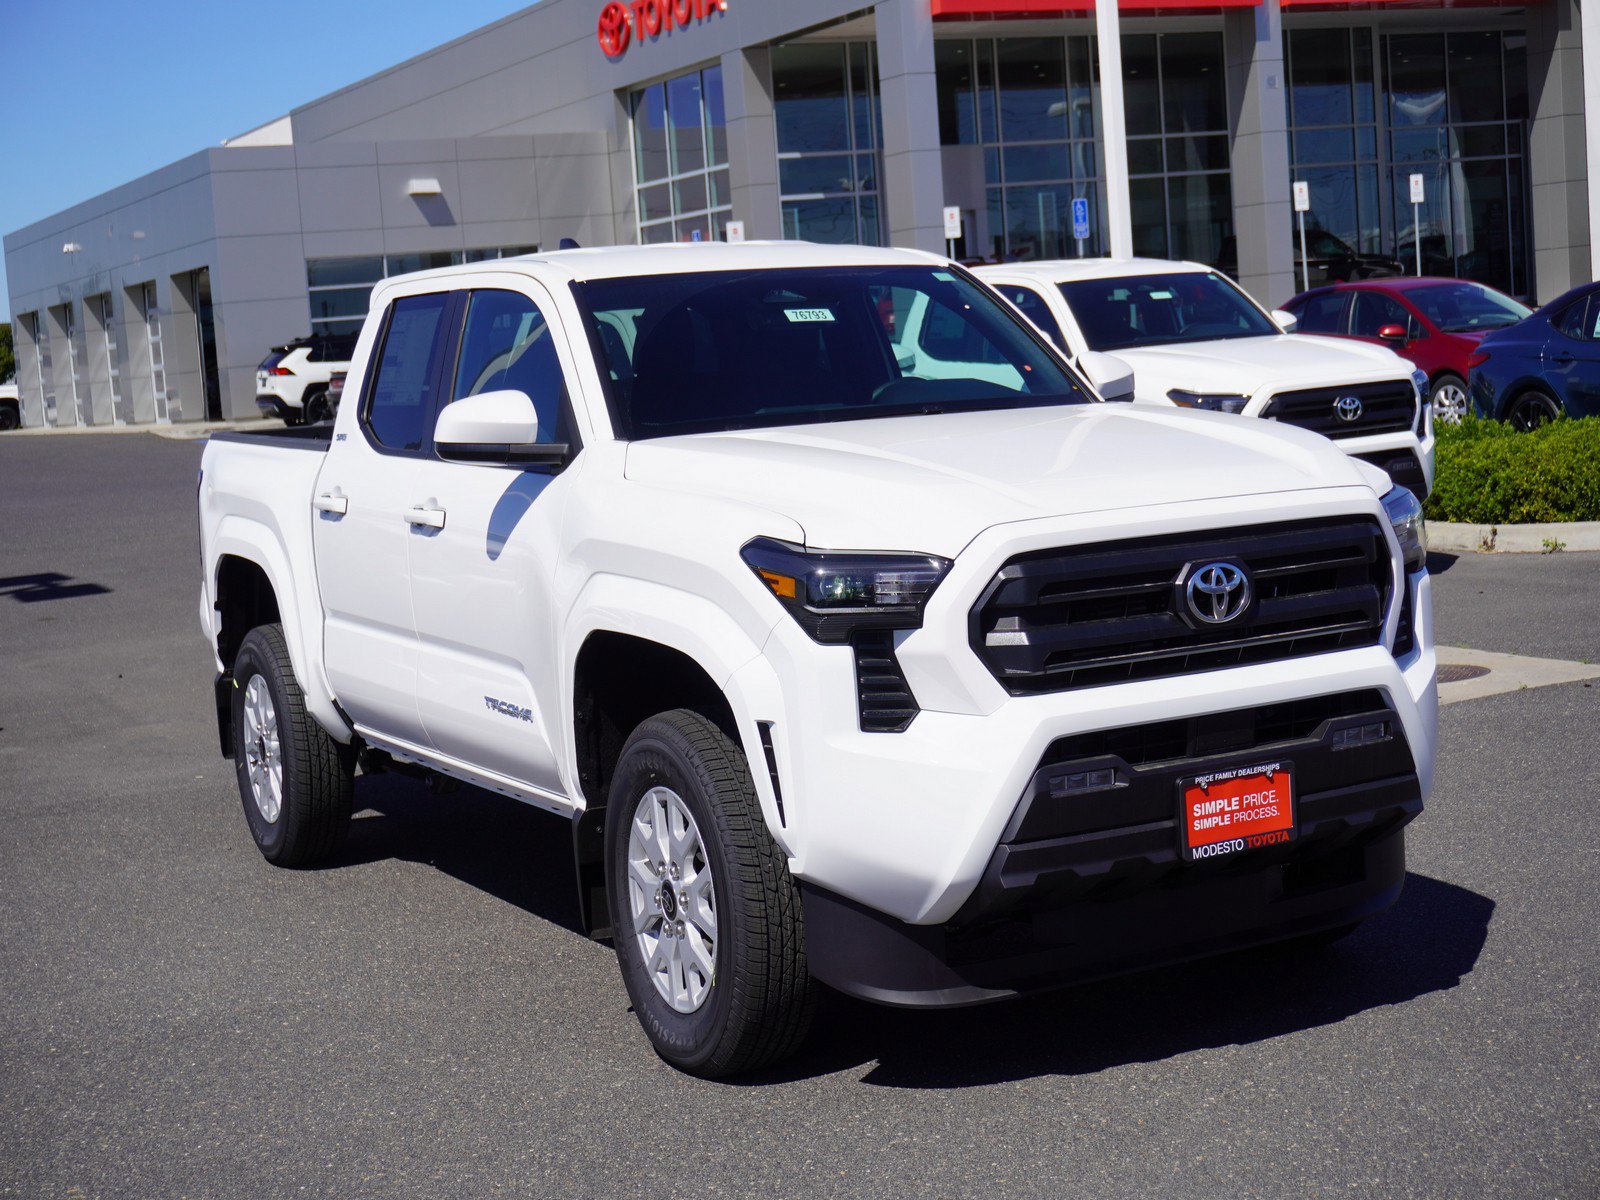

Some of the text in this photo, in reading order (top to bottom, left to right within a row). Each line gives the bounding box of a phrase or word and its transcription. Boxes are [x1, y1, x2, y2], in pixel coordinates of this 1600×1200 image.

[791, 310, 828, 320] 76793
[484, 696, 533, 723] TACOMA
[1195, 763, 1280, 784] PRICE FAMILY DEALERSHIPS
[1193, 790, 1279, 817] SIMPLE PRICE.
[1193, 805, 1280, 831] SIMPLE PROCESS.
[1192, 831, 1290, 860] MODESTO TOYOTA
